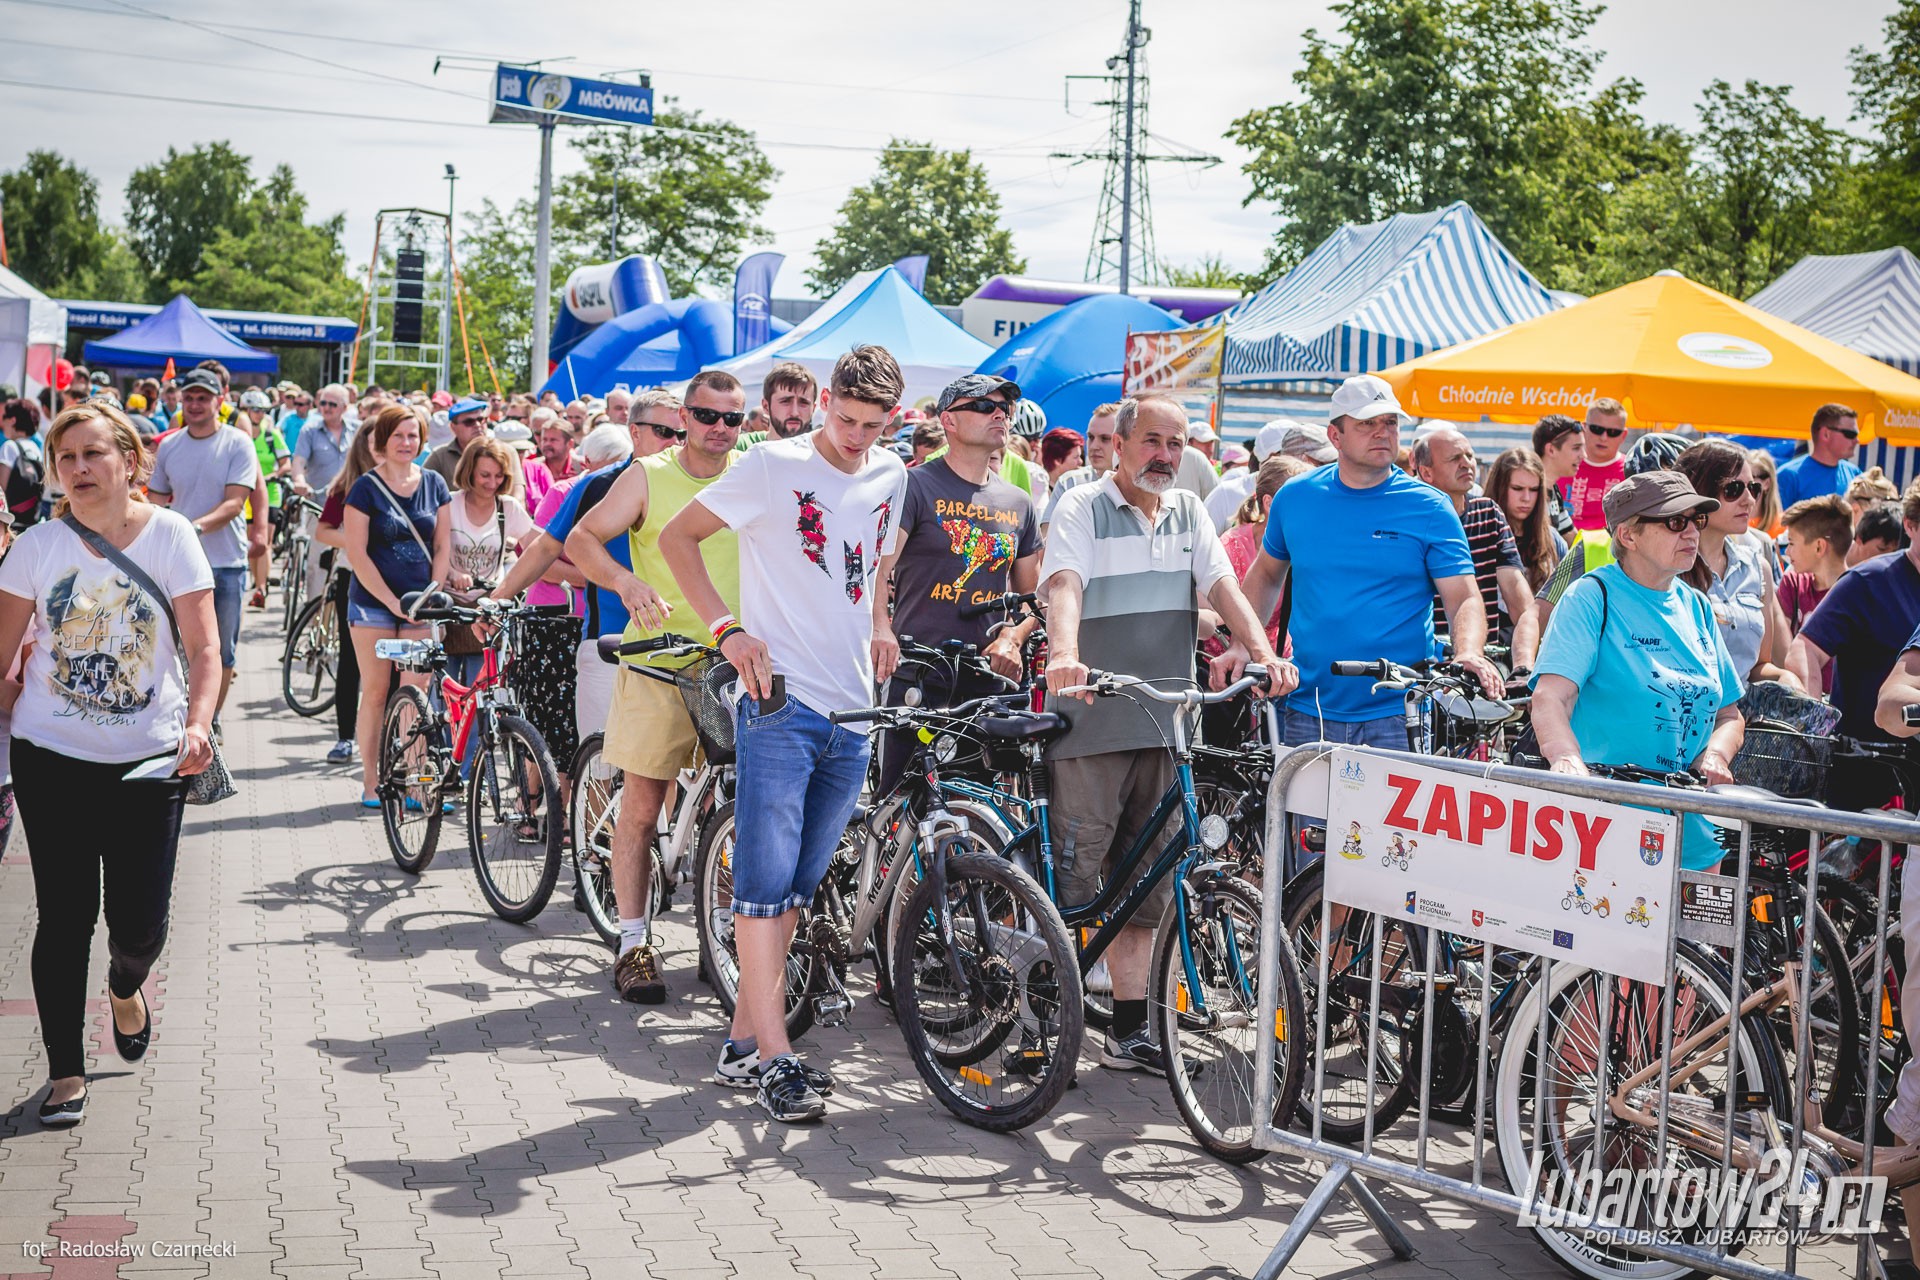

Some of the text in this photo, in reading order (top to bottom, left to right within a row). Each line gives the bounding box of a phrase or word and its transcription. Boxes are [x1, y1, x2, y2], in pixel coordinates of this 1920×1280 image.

[578, 89, 650, 115] MRÓWKA
[1438, 384, 1515, 405] Chłodnie
[1521, 386, 1597, 408] Wschód
[935, 499, 1020, 527] BARCELONA
[930, 582, 967, 605] ART
[1383, 773, 1613, 871] ZAPISY
[1419, 898, 1446, 910] PROGRAM
[1696, 885, 1733, 901] SLS
[1696, 899, 1732, 908] GROUP
[1419, 904, 1452, 918] REGIONALNY
